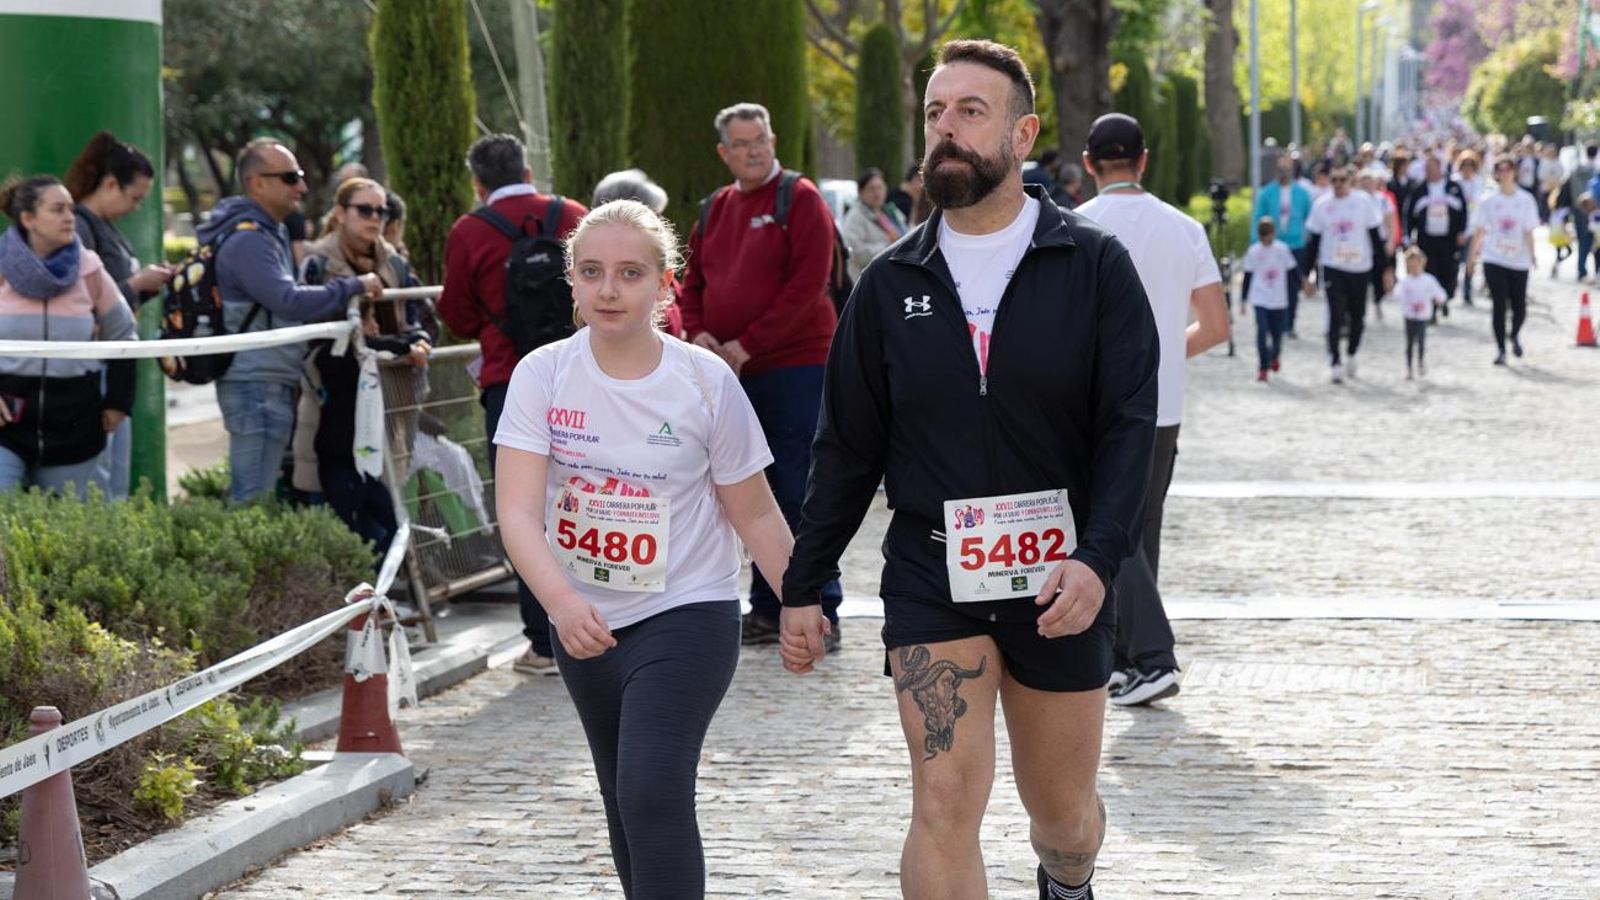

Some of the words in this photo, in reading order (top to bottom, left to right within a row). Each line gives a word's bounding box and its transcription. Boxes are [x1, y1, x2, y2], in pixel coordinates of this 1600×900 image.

[570, 432, 600, 443] POPULAR
[588, 499, 605, 509] XXVII
[606, 500, 630, 510] CARRERA
[996, 501, 1013, 511] XXVII
[1014, 499, 1035, 508] CARRERA
[557, 518, 657, 566] 5480
[960, 528, 1068, 571] 5482
[576, 555, 602, 567] MINERVA
[603, 562, 631, 572] FOREVER
[988, 569, 1018, 577] MINERVA
[1021, 566, 1045, 574] FOREVER
[56, 725, 89, 753] DEPORTES
